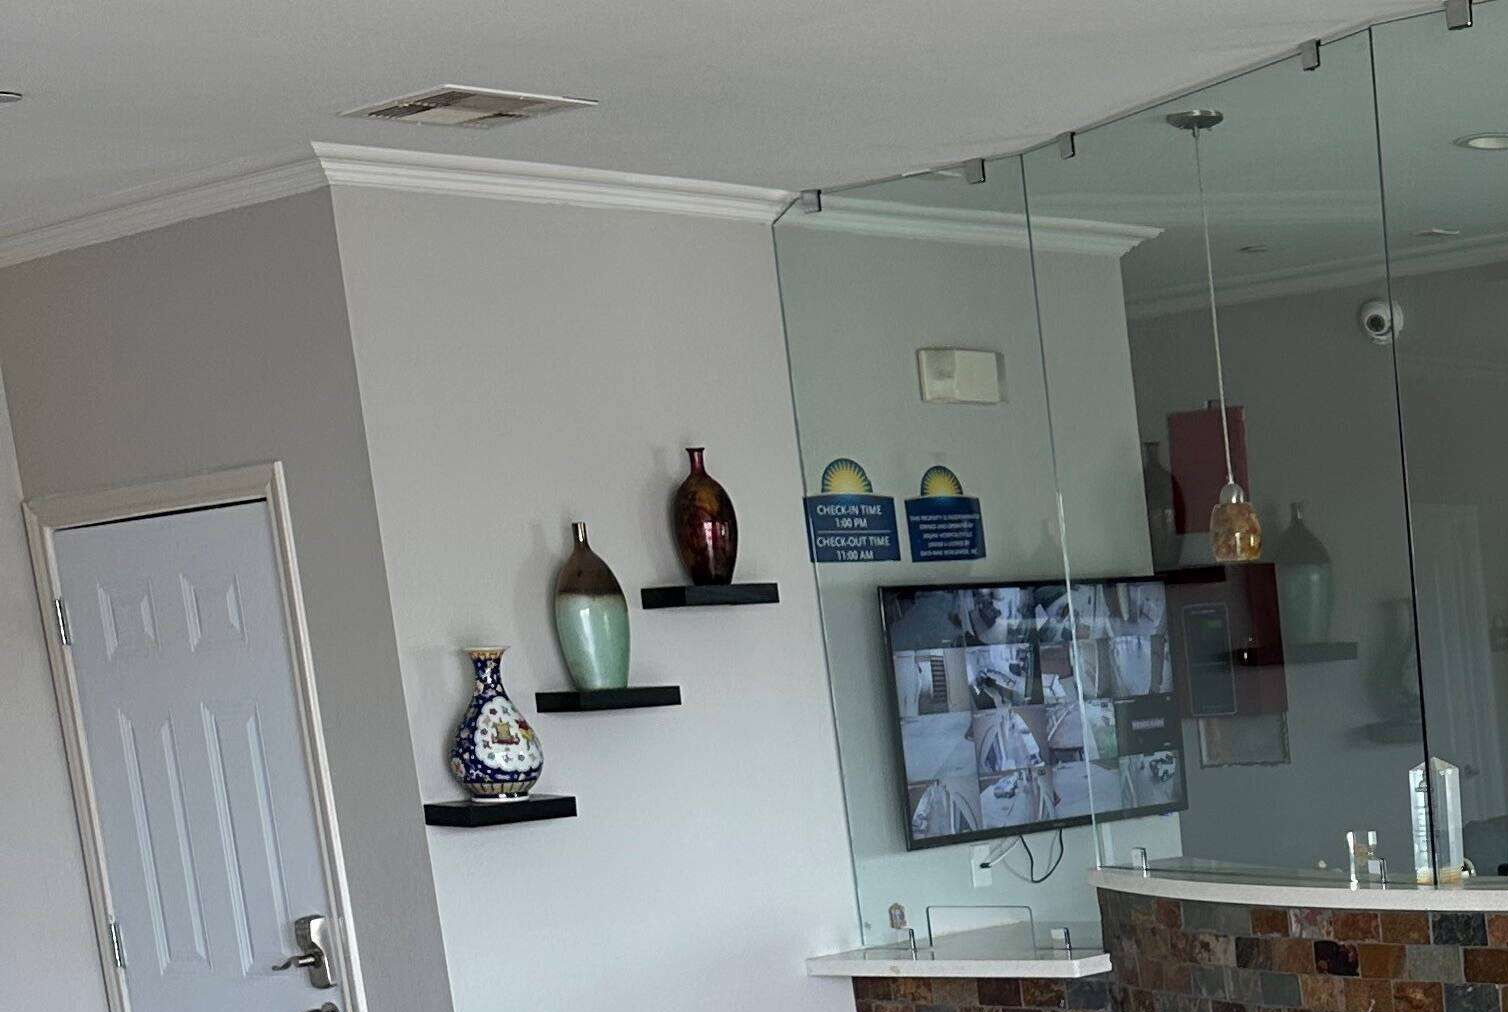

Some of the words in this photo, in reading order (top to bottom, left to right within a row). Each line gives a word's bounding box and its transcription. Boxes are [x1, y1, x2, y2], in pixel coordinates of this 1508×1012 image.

[816, 505, 859, 516] CHECK-IN
[861, 505, 883, 516] TIME
[834, 518, 853, 529] 1:00
[854, 518, 868, 528] PM
[816, 536, 867, 548] CHECK-OUT
[867, 536, 891, 547] TIME
[836, 550, 859, 561] 11:00
[860, 550, 874, 560] AM
